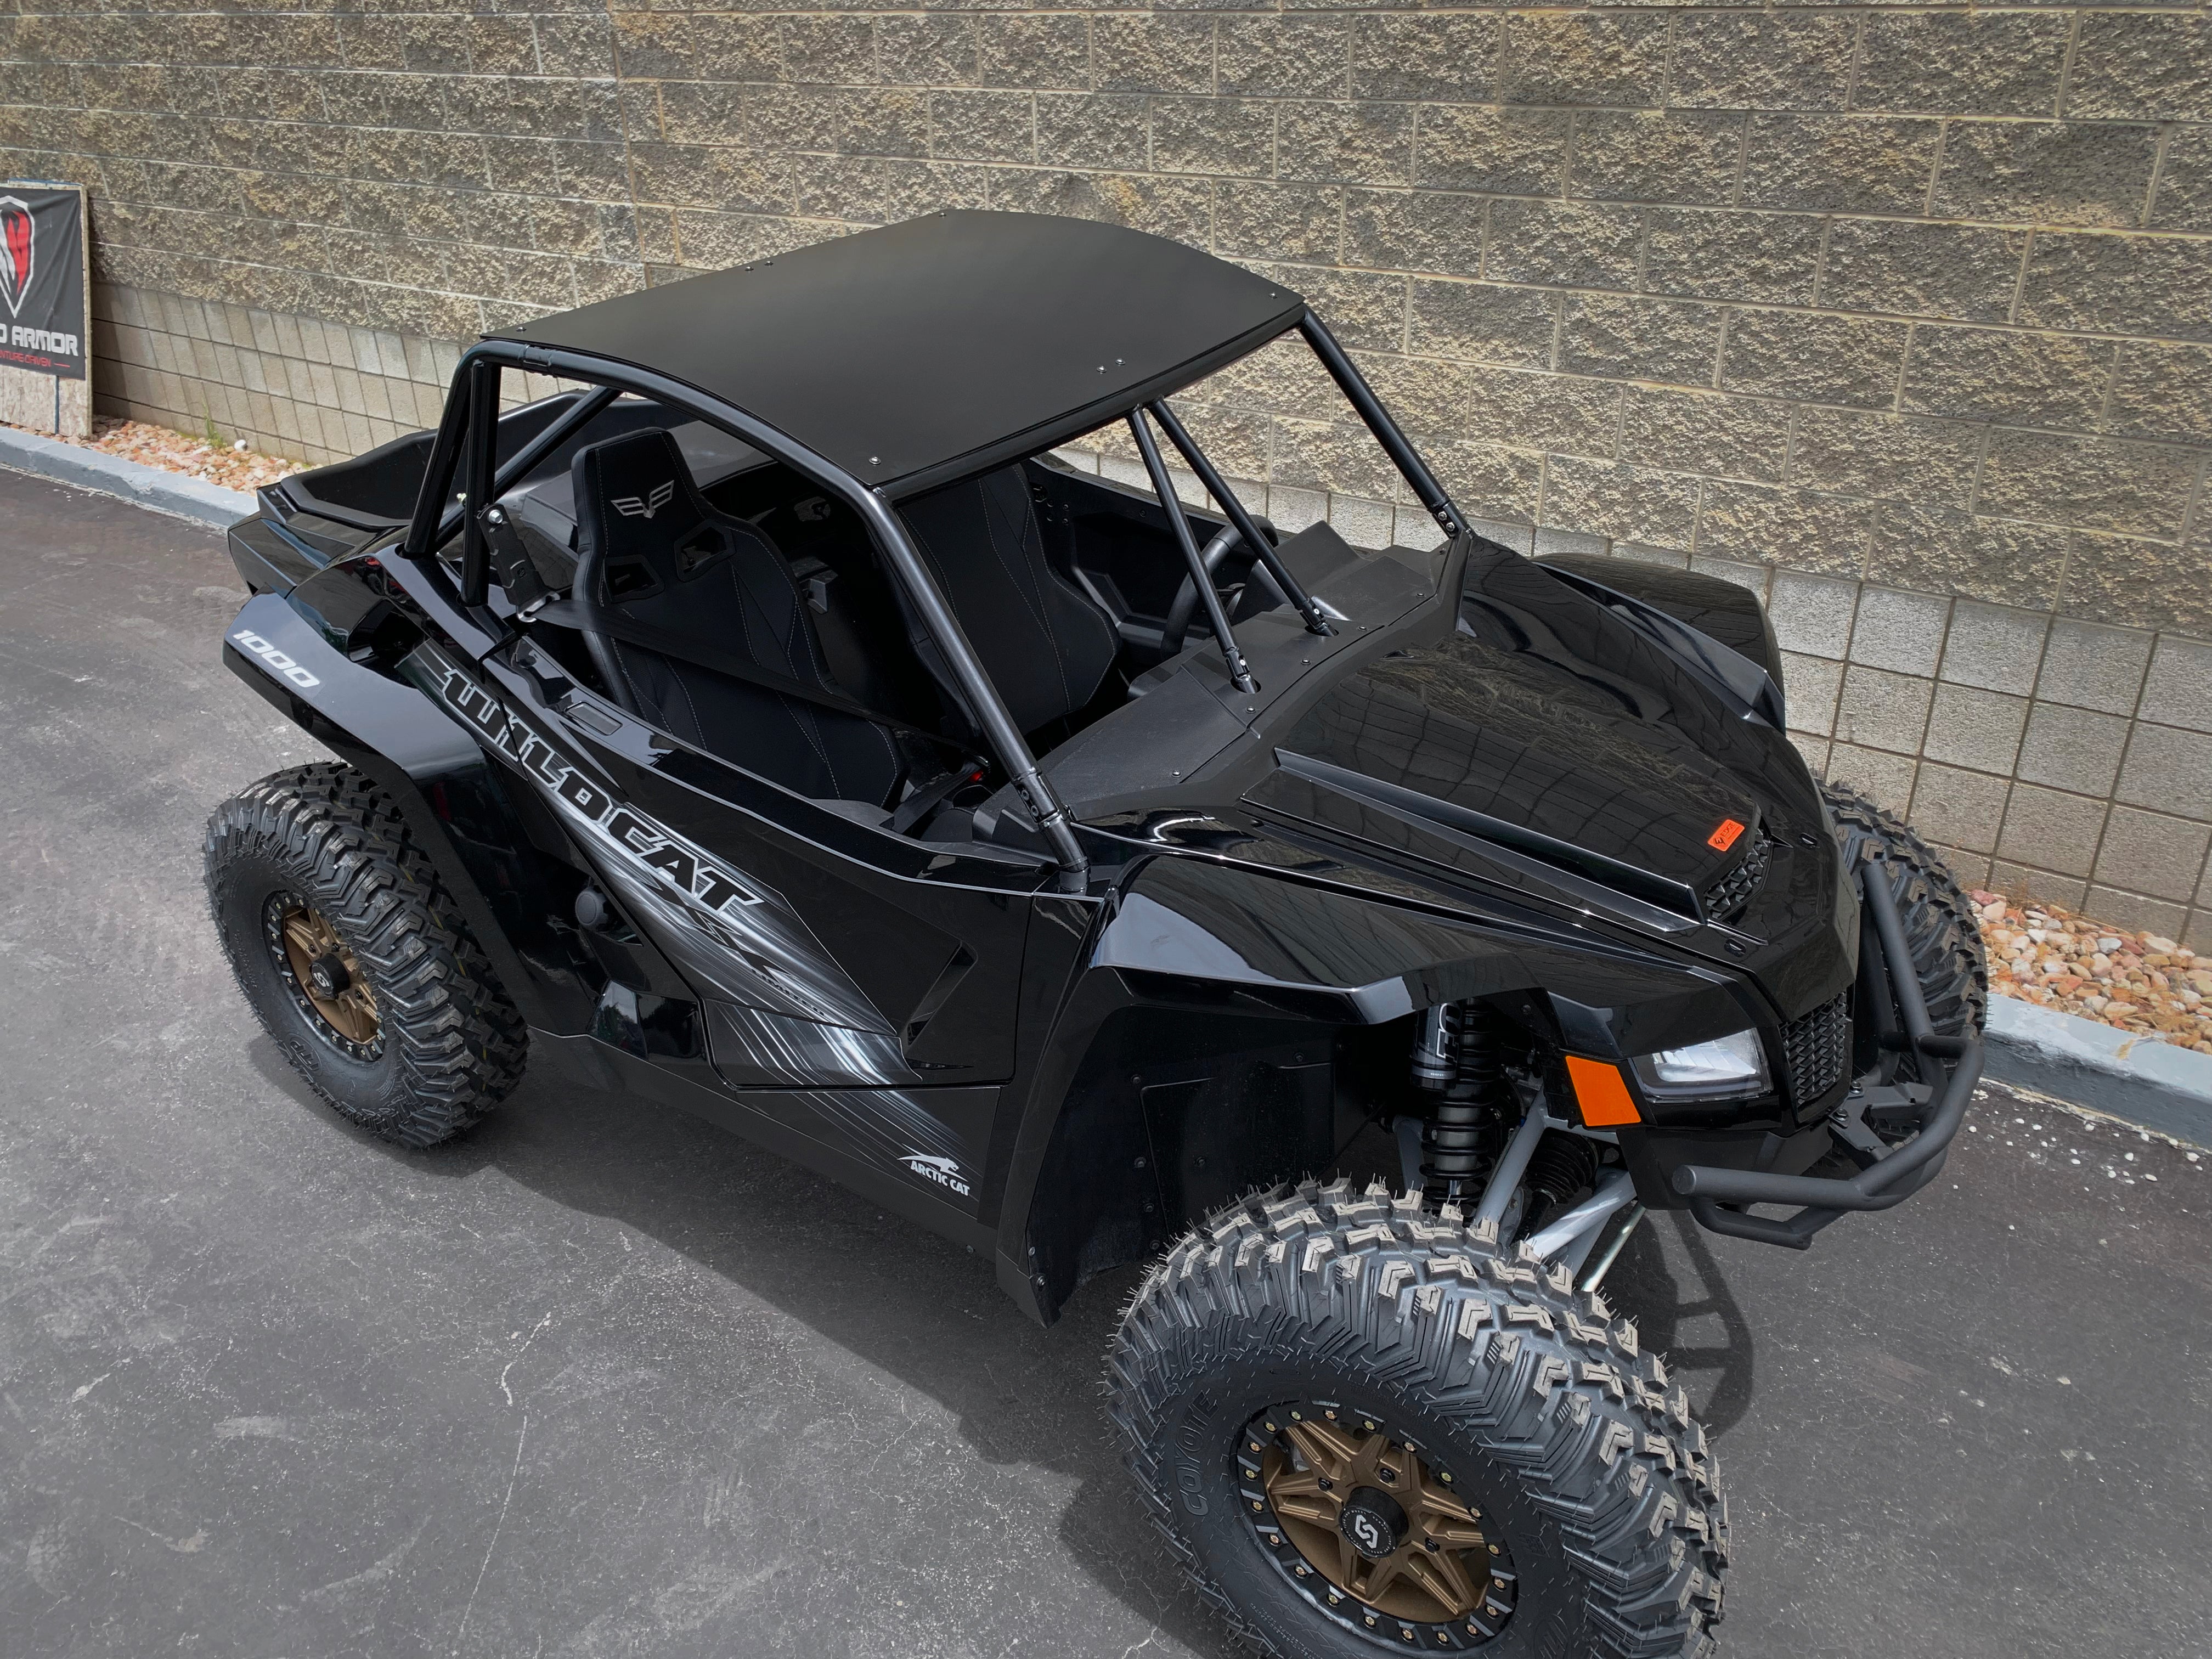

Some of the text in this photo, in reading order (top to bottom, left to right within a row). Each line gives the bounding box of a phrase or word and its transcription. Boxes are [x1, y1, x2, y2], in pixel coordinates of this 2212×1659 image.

[12, 325, 78, 356] ARMOR
[233, 630, 320, 687] 1000
[441, 668, 764, 915] WILDCAT
[1720, 822, 1735, 837] EDGE
[751, 968, 825, 1017] LIMITED
[910, 1160, 970, 1196] ARCTIC CAT
[1175, 1390, 1220, 1516] COYOTE
